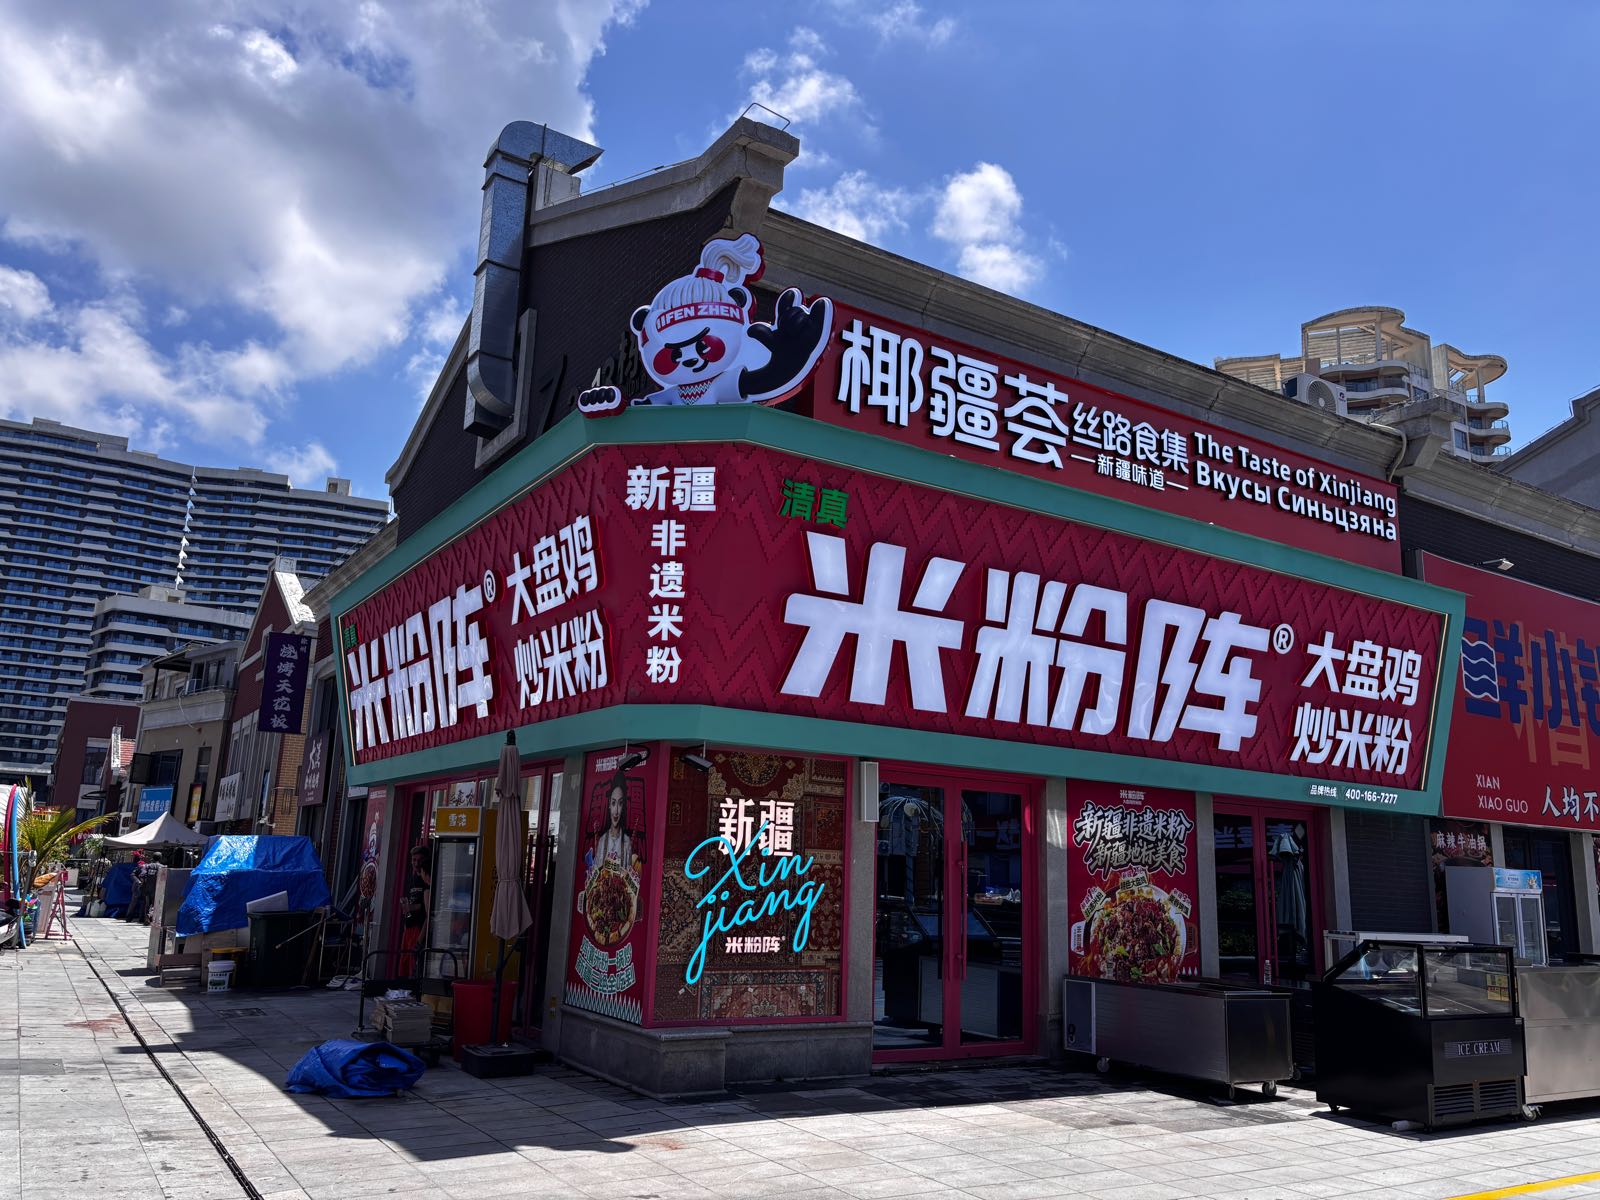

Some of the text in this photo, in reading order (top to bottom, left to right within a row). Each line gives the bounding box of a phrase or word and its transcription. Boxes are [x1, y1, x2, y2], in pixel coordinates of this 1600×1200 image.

[698, 304, 740, 320] ZHEN
[838, 318, 1070, 470] 椰疆荟
[1072, 401, 1190, 474] 丝路食集
[1096, 453, 1166, 491] 新疆味道
[625, 464, 717, 513] 新疆
[780, 478, 849, 529] 清真
[1194, 431, 1398, 519] The Taste of Xinjiang
[1196, 460, 1398, 542] Вкусы Синьцзяна
[506, 514, 600, 626] 大盘鸡
[645, 519, 687, 685] 非遗米粉
[347, 583, 495, 752] 米粉阵
[513, 608, 610, 711] 炒米粉
[779, 530, 1272, 753] 米粉阵
[1299, 630, 1423, 707] 大盘鸡
[1461, 615, 1600, 738] 鲜小
[269, 643, 299, 730] 烧烤天花板
[1289, 702, 1414, 776] 炒米粉
[1310, 784, 1399, 806] 品牌热线 400-166-7277
[1475, 773, 1501, 790] XIAN
[1477, 794, 1529, 814] XIAO GUO
[684, 819, 815, 909] Xin
[718, 797, 795, 858] 新疆
[1074, 801, 1194, 854] 新疆非遗米粉
[1088, 838, 1188, 880] 新疆地标美食
[1435, 829, 1488, 852] 麻辣牛油锅
[685, 880, 826, 985] jiang
[724, 935, 782, 954] 米粉阵
[1457, 1041, 1501, 1056] ICE CREAM
